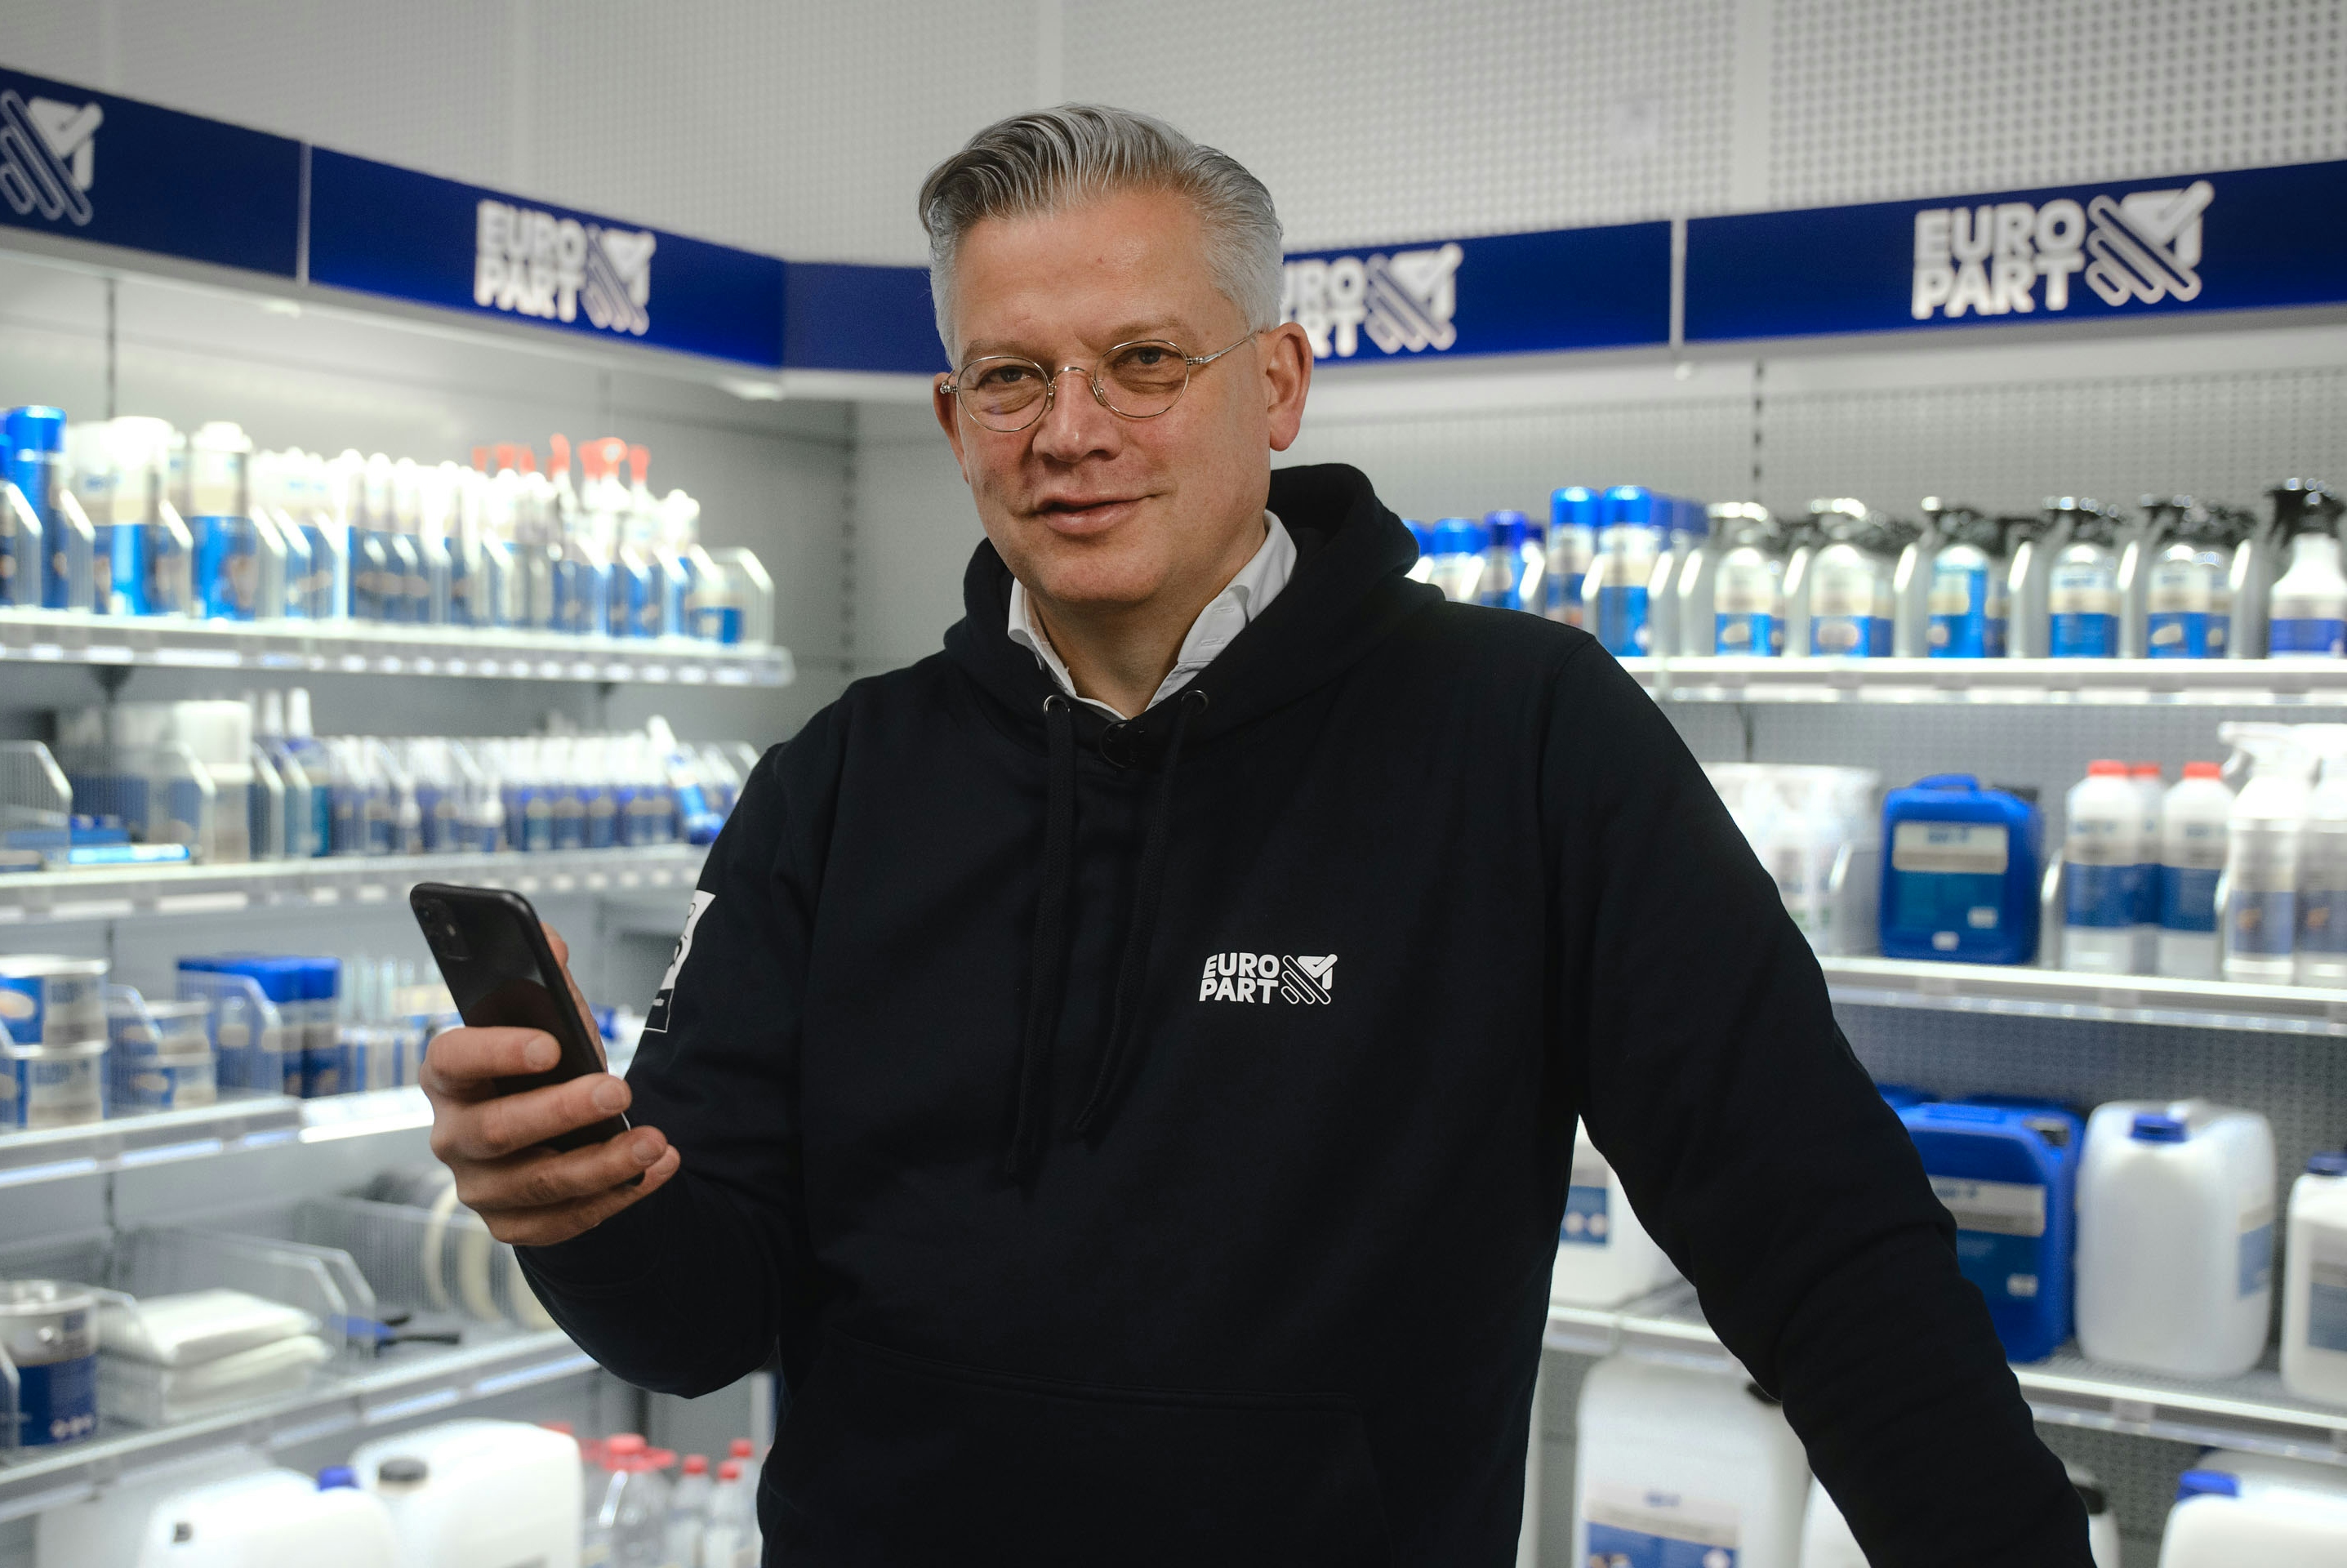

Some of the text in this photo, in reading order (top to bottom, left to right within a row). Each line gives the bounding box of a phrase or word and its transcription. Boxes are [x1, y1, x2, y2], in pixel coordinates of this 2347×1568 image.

[477, 199, 587, 270] EURO
[1914, 198, 2086, 262] EURO
[474, 255, 586, 323] PART
[1912, 252, 2085, 319] PART
[1199, 978, 1279, 1004] PART
[1203, 953, 1280, 978] EURO
